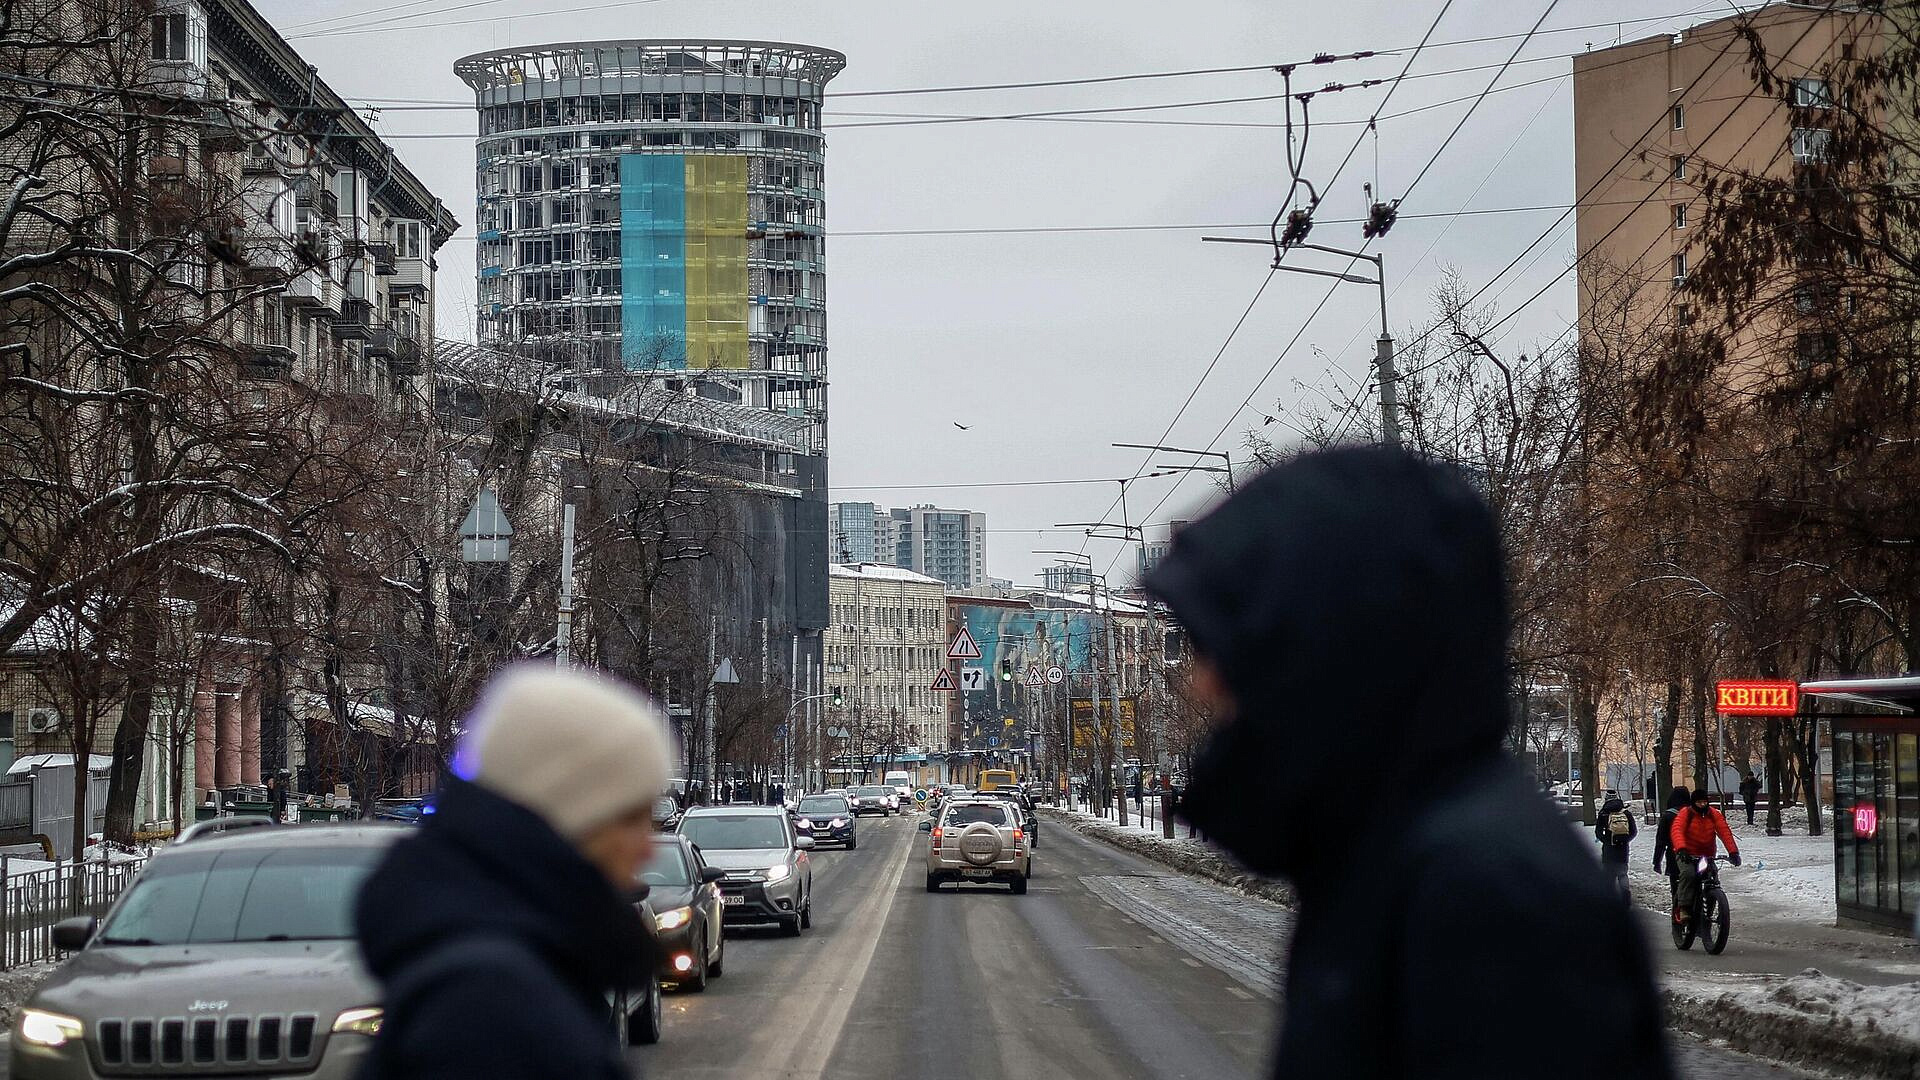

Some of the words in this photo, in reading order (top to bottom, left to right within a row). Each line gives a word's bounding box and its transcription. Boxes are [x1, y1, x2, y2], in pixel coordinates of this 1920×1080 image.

[1049, 671, 1061, 679] 40
[1718, 688, 1789, 706] КВІТИ
[188, 1000, 229, 1011] Jeep
